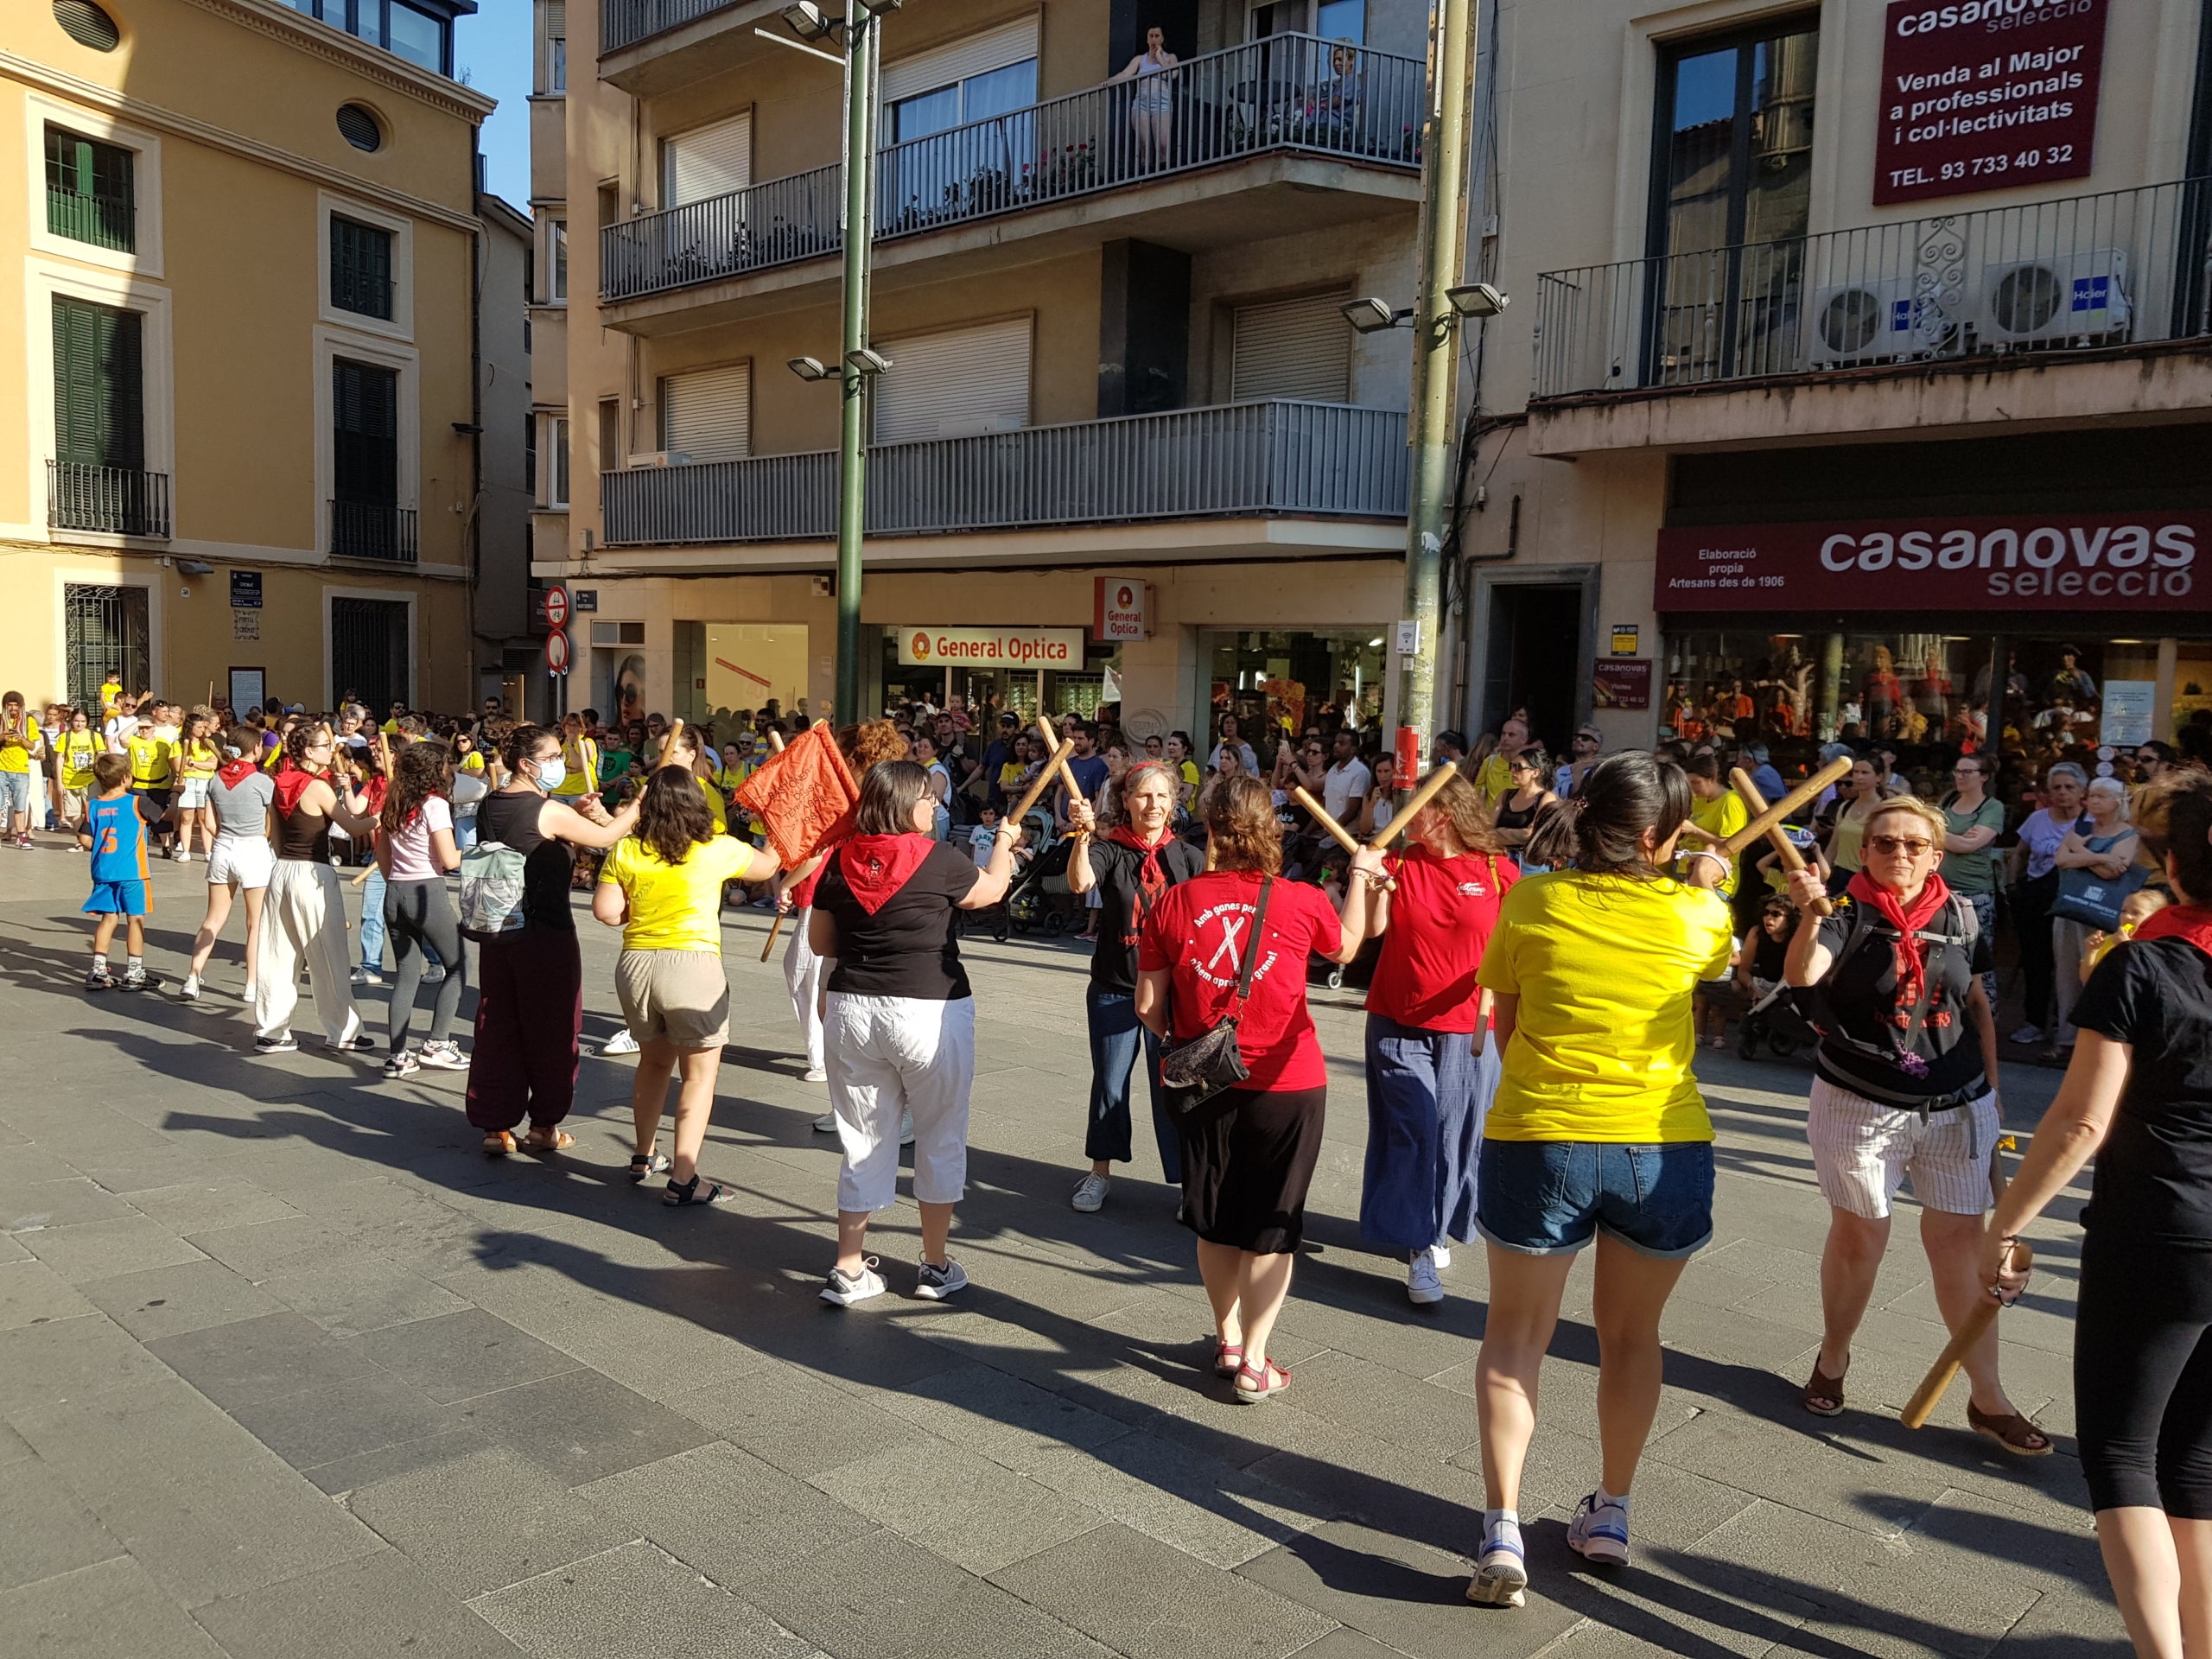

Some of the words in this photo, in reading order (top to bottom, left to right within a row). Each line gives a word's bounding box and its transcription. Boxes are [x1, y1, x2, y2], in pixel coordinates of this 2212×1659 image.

[1897, 66, 1971, 92] Venda
[1978, 57, 2000, 77] al
[2008, 44, 2084, 74] Major
[1890, 105, 1904, 120] a
[1910, 71, 2084, 121] professionals
[1894, 127, 1903, 145] i
[1908, 100, 2074, 143] col·lectivitats
[1890, 168, 1935, 188] TEL.
[1940, 161, 1966, 181] 93
[1971, 155, 2008, 175] 733
[2014, 149, 2040, 168] 40
[2045, 144, 2074, 165] 32
[1699, 548, 1757, 560] Elaboració
[1820, 524, 2196, 571] casanovas
[1669, 577, 1716, 588] Artesans
[1719, 576, 1738, 588] des
[1741, 576, 1755, 587] de
[1758, 575, 1784, 587] 1906
[1709, 563, 1744, 576] propia
[1987, 564, 2196, 596] selecció
[1108, 610, 1141, 623] General
[1110, 622, 1138, 636] Optica
[937, 637, 1003, 658] General
[1008, 637, 1067, 664] Optica
[1599, 664, 1647, 672] casanovas
[1193, 908, 1213, 928] Amb
[1212, 903, 1240, 916] ganes
[1254, 950, 1278, 981] grans!
